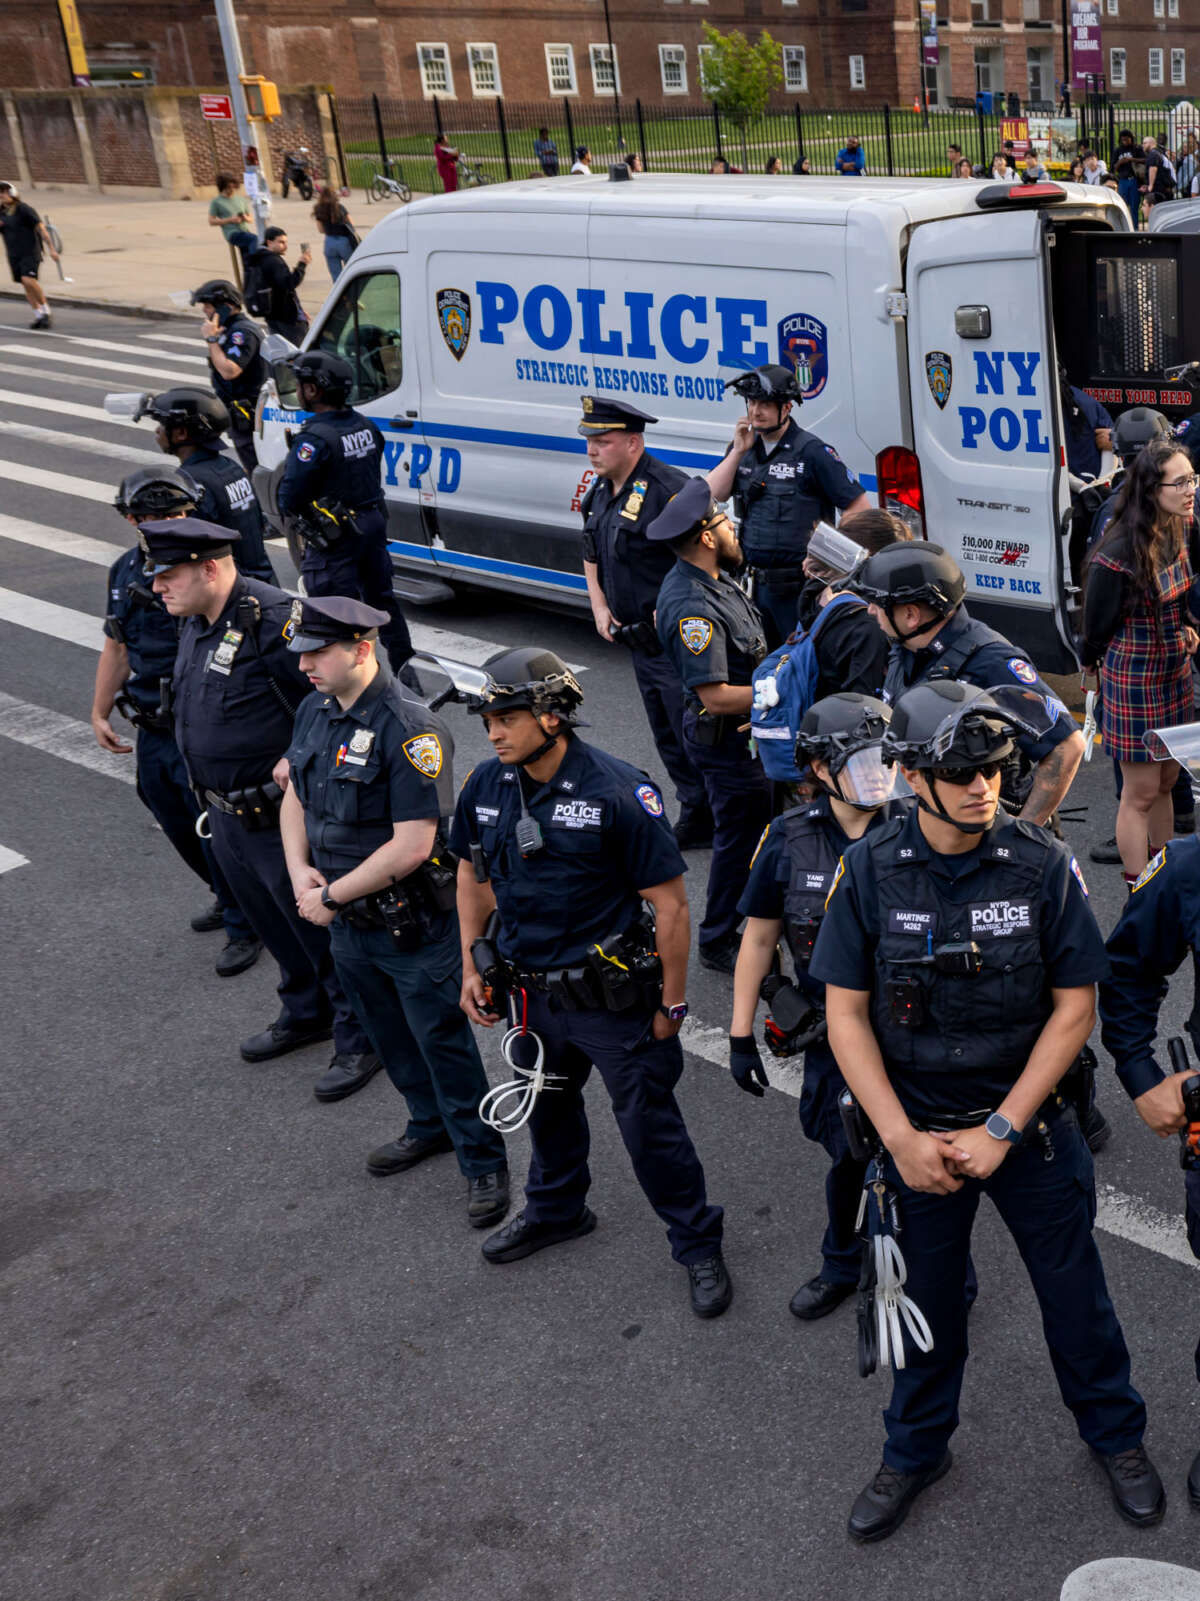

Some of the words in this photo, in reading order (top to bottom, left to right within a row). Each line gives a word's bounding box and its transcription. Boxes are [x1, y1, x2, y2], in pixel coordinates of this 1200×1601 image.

[1002, 121, 1017, 141] ALL
[475, 281, 769, 370] POLICE
[783, 316, 823, 340] POLICE
[516, 358, 590, 388] STRATEGIC
[594, 366, 669, 396] RESPONSE
[674, 375, 726, 402] GROUP
[973, 351, 1040, 396] NY
[1126, 389, 1157, 404] YOUR
[1160, 390, 1192, 406] HEAD
[958, 406, 1050, 453] POL
[341, 428, 374, 452] NYPD
[383, 440, 461, 494] YPD
[769, 464, 796, 475] POLICE
[225, 477, 252, 503] NYPD
[962, 535, 993, 550] $10,000
[995, 540, 1030, 554] REWARD
[963, 552, 974, 561] CALL
[975, 573, 1005, 590] KEEP
[1009, 578, 1042, 595] BACK
[552, 815, 576, 823] STRATEGIC
[554, 804, 602, 820] POLICE
[809, 809, 819, 817] S4
[900, 849, 913, 858] S2
[996, 848, 1009, 857] S2
[806, 874, 824, 882] YANG
[990, 901, 1010, 909] NYPD
[896, 912, 931, 923] MARTINEZ
[971, 906, 1030, 925] POLICE
[972, 923, 1001, 932] STRATEGIC
[1002, 919, 1031, 928] RESPONSE
[992, 928, 1014, 937] GROUP
